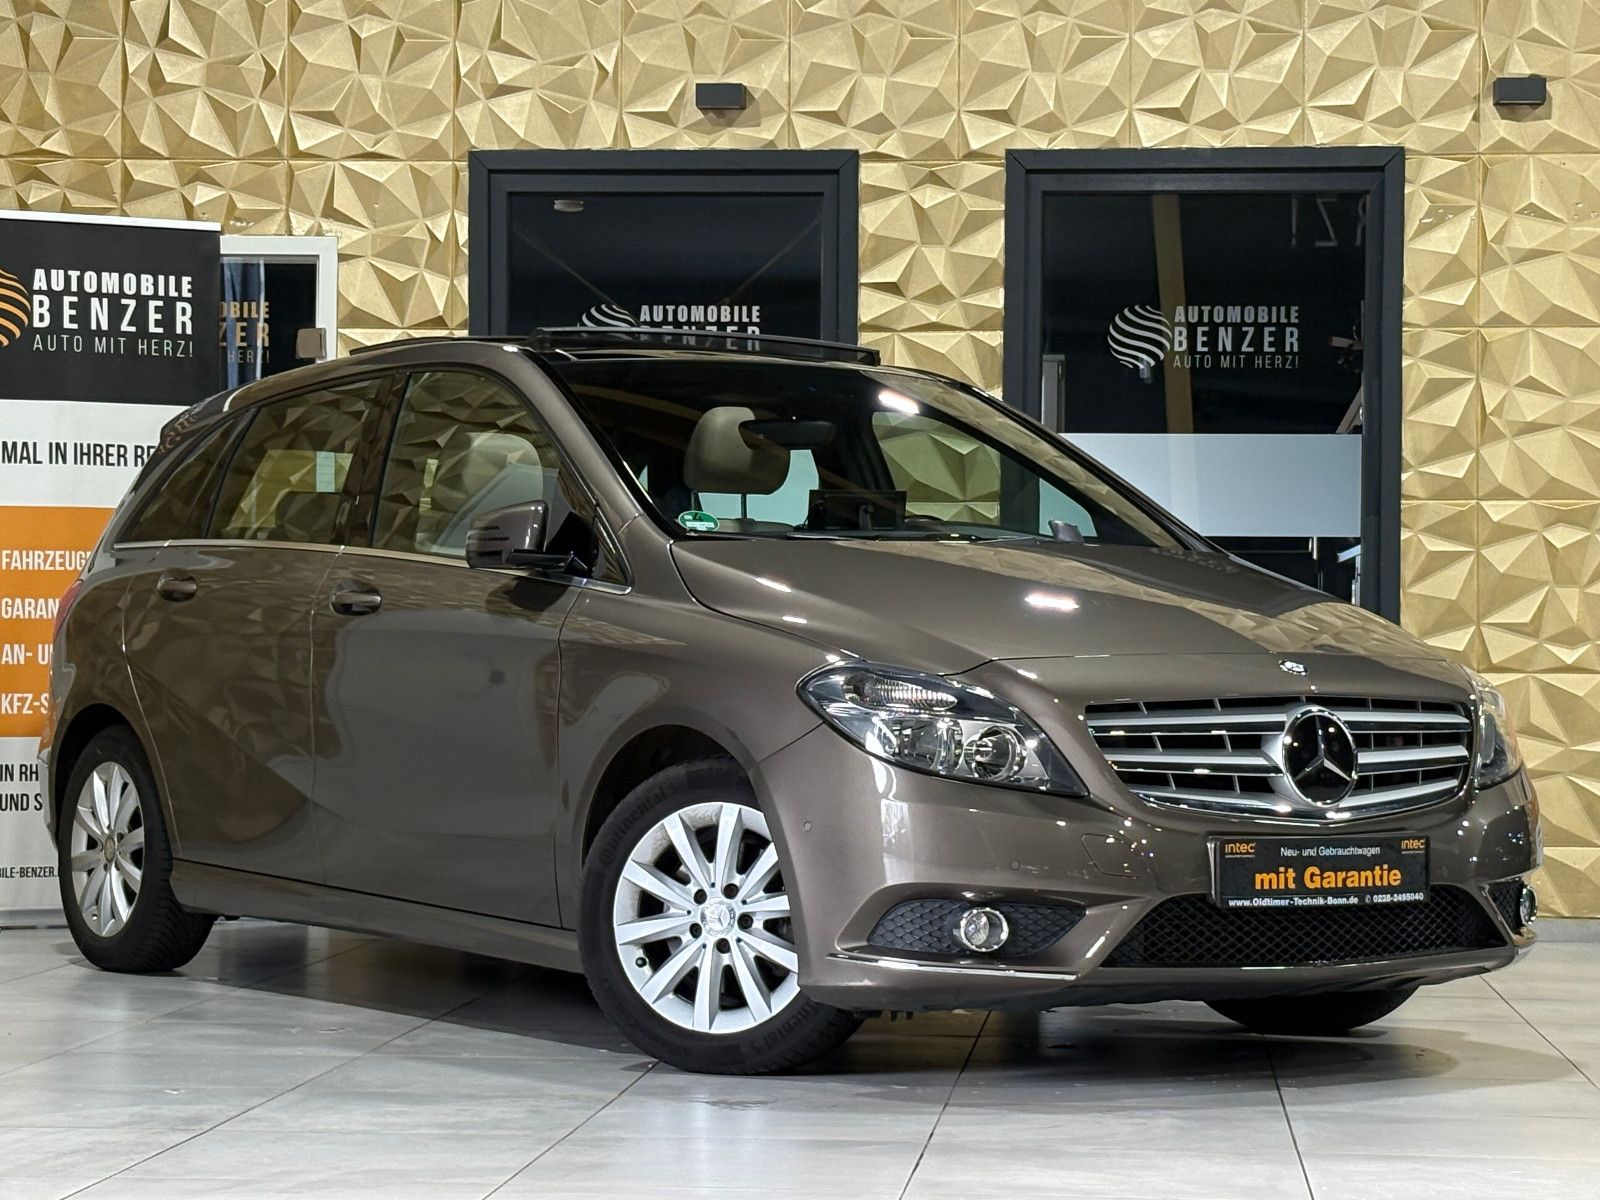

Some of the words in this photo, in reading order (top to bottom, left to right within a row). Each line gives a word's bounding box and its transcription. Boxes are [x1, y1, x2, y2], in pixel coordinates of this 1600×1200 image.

[33, 268, 193, 298] AUTOMOBILE
[32, 295, 193, 334] BENZER
[640, 305, 760, 322] AUTOMOBILE
[1174, 305, 1299, 323] AUTOMOBILE
[33, 335, 82, 352] AUTO
[94, 336, 126, 354] MIT
[138, 339, 194, 357] HERZ!
[1174, 326, 1299, 353] BENZER
[1173, 355, 1212, 369] AUTO
[1220, 355, 1245, 369] MIT
[1254, 355, 1299, 369] HERZ!
[1, 440, 43, 465] MAL
[49, 442, 67, 466] IN
[73, 442, 128, 467] IHRER
[1, 550, 92, 571] FAHRZEUG
[1, 643, 33, 665] AN-
[0, 793, 29, 811] UND
[1225, 842, 1256, 853] intec
[1280, 847, 1300, 857] Neu-
[1302, 846, 1317, 856] und
[1319, 846, 1380, 857] Gebrauchtwagen
[1401, 839, 1425, 849] intec
[1255, 866, 1296, 890] mit
[1304, 864, 1402, 889] Garantie
[1228, 895, 1358, 907] www.Oldtimer-Technik-Bonn.de
